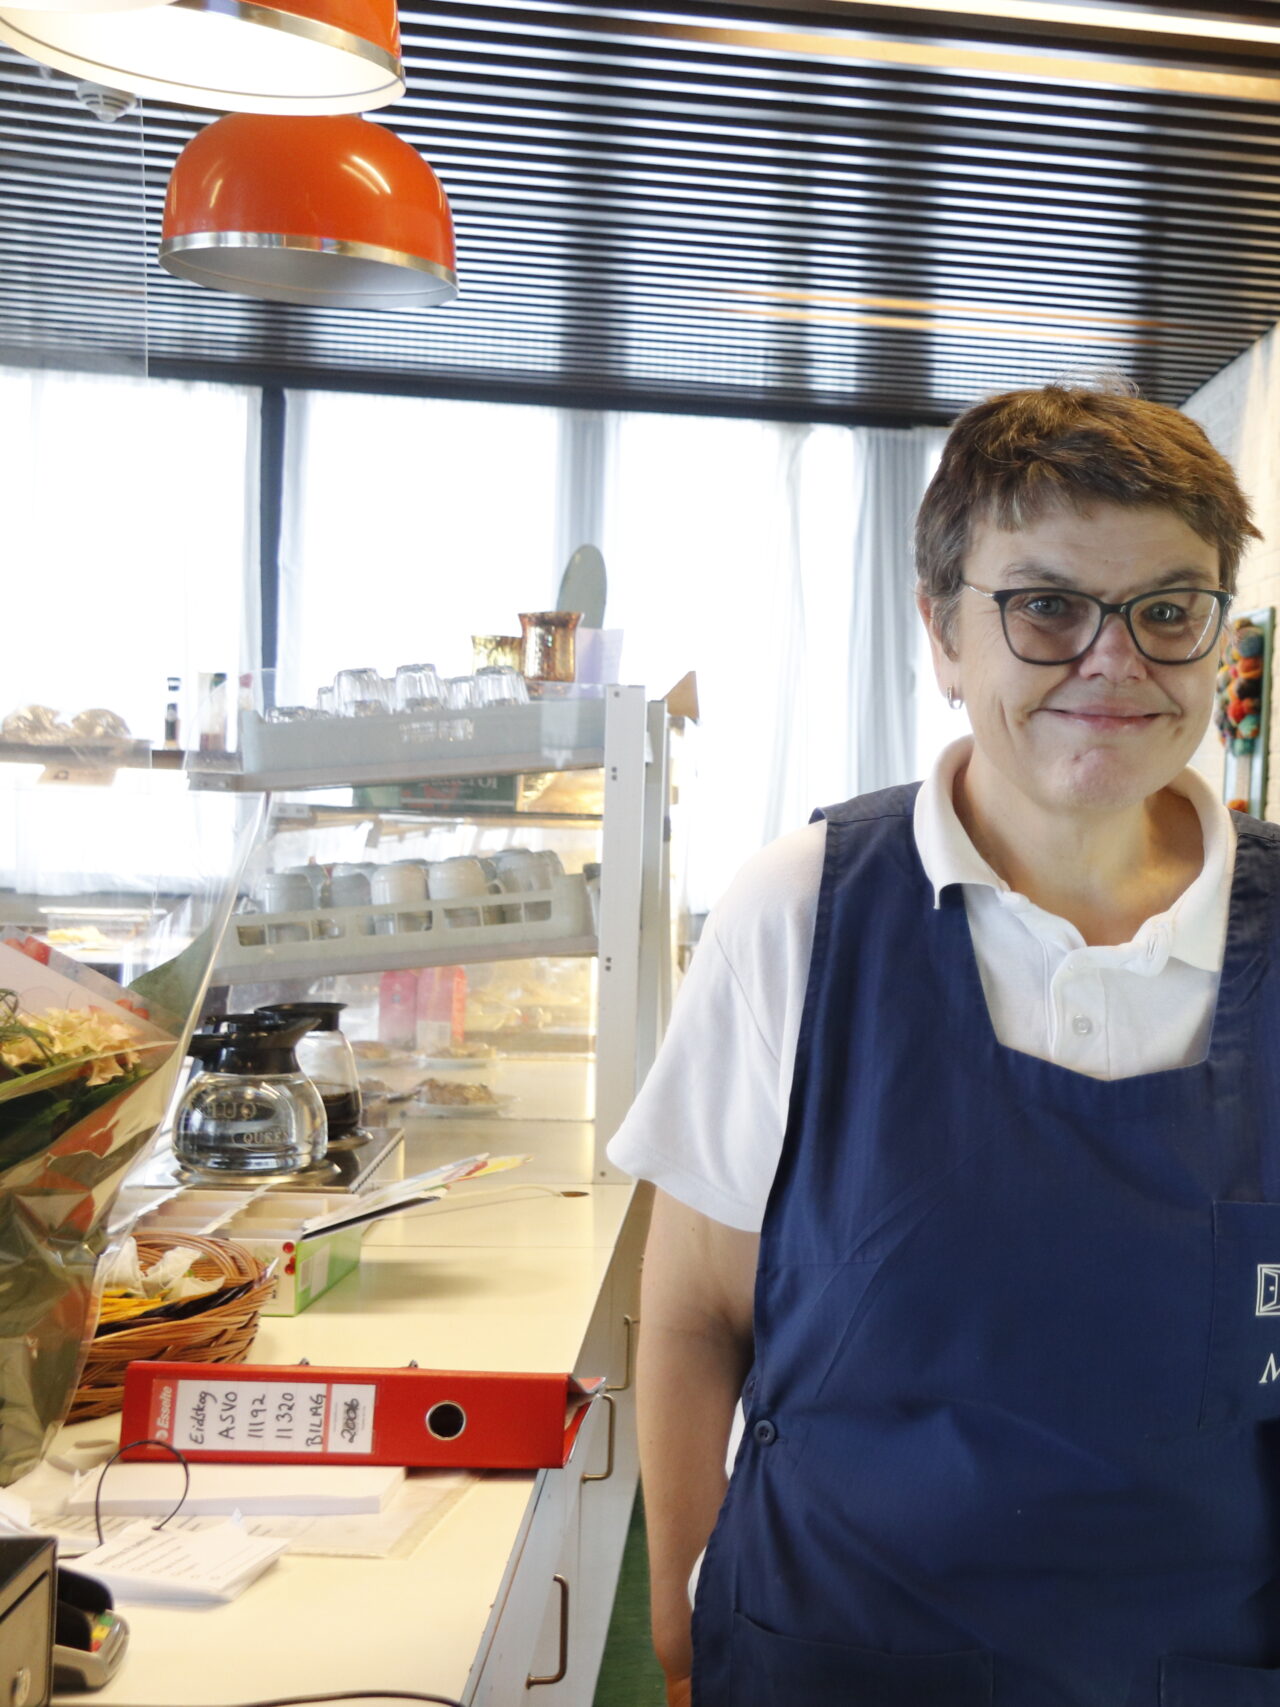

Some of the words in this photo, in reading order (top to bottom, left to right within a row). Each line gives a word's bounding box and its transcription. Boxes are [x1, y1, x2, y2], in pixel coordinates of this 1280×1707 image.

[156, 1386, 172, 1429] Esselte
[189, 1391, 218, 1445] Eidskog
[218, 1391, 238, 1440] ASVO
[306, 1393, 326, 1446] BILAG
